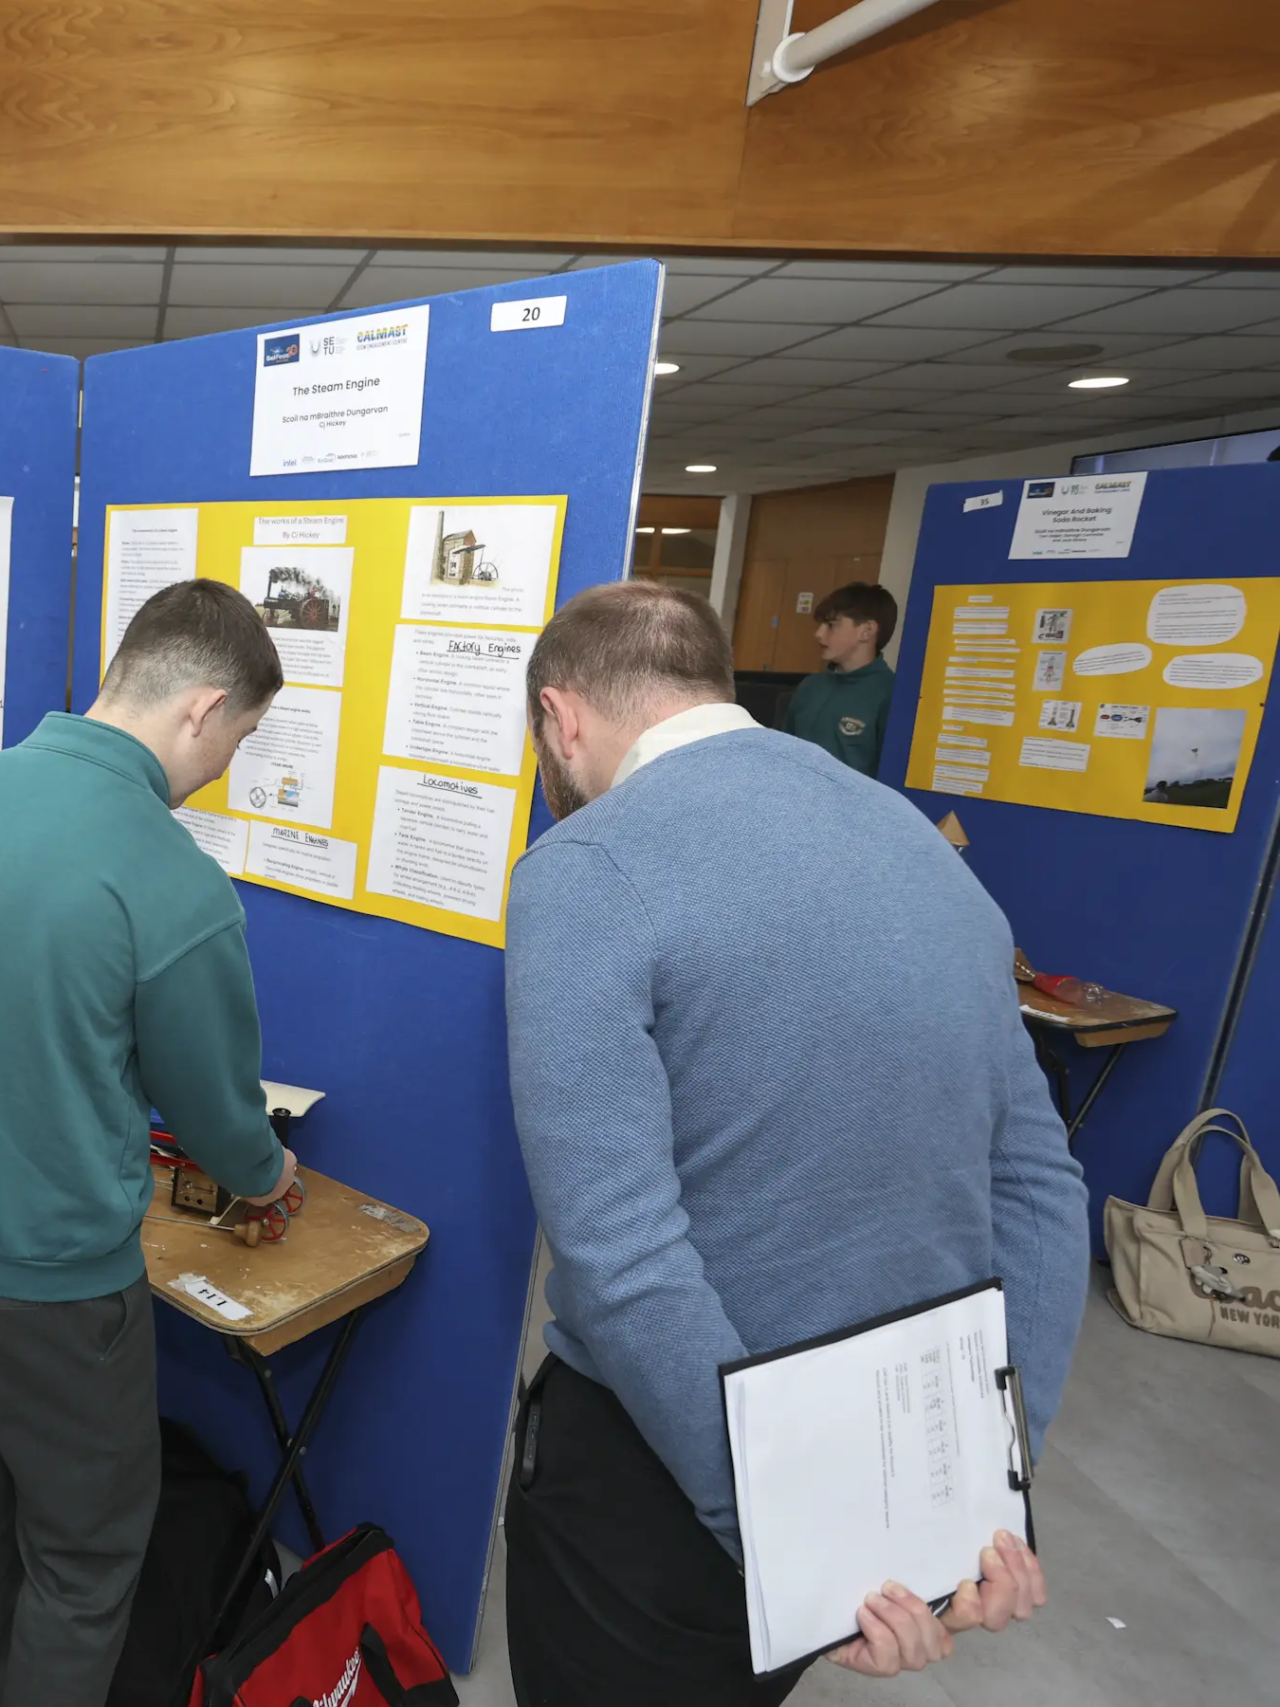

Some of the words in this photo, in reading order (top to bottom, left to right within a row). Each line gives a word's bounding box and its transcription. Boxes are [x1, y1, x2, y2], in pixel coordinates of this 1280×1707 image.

[522, 307, 540, 322] 20
[357, 325, 408, 343] CALMAST
[324, 337, 334, 346] SE
[324, 346, 335, 355] TU
[293, 386, 310, 397] The
[312, 382, 344, 394] Steam
[346, 376, 380, 391] Engine
[282, 415, 298, 423] Scoil
[310, 411, 345, 420] mBraithre
[346, 406, 388, 417] Dungarvan
[1087, 507, 1112, 515] Baking
[258, 517, 269, 525] The
[271, 517, 289, 525] works
[291, 517, 297, 525] of
[303, 517, 323, 525] Steam
[324, 517, 344, 526] Engine
[299, 531, 320, 539] Hickey
[488, 643, 521, 657] Engines
[423, 774, 478, 794] Locomotives
[1221, 1306, 1249, 1323] NEW
[1254, 1312, 1280, 1329] YOR
